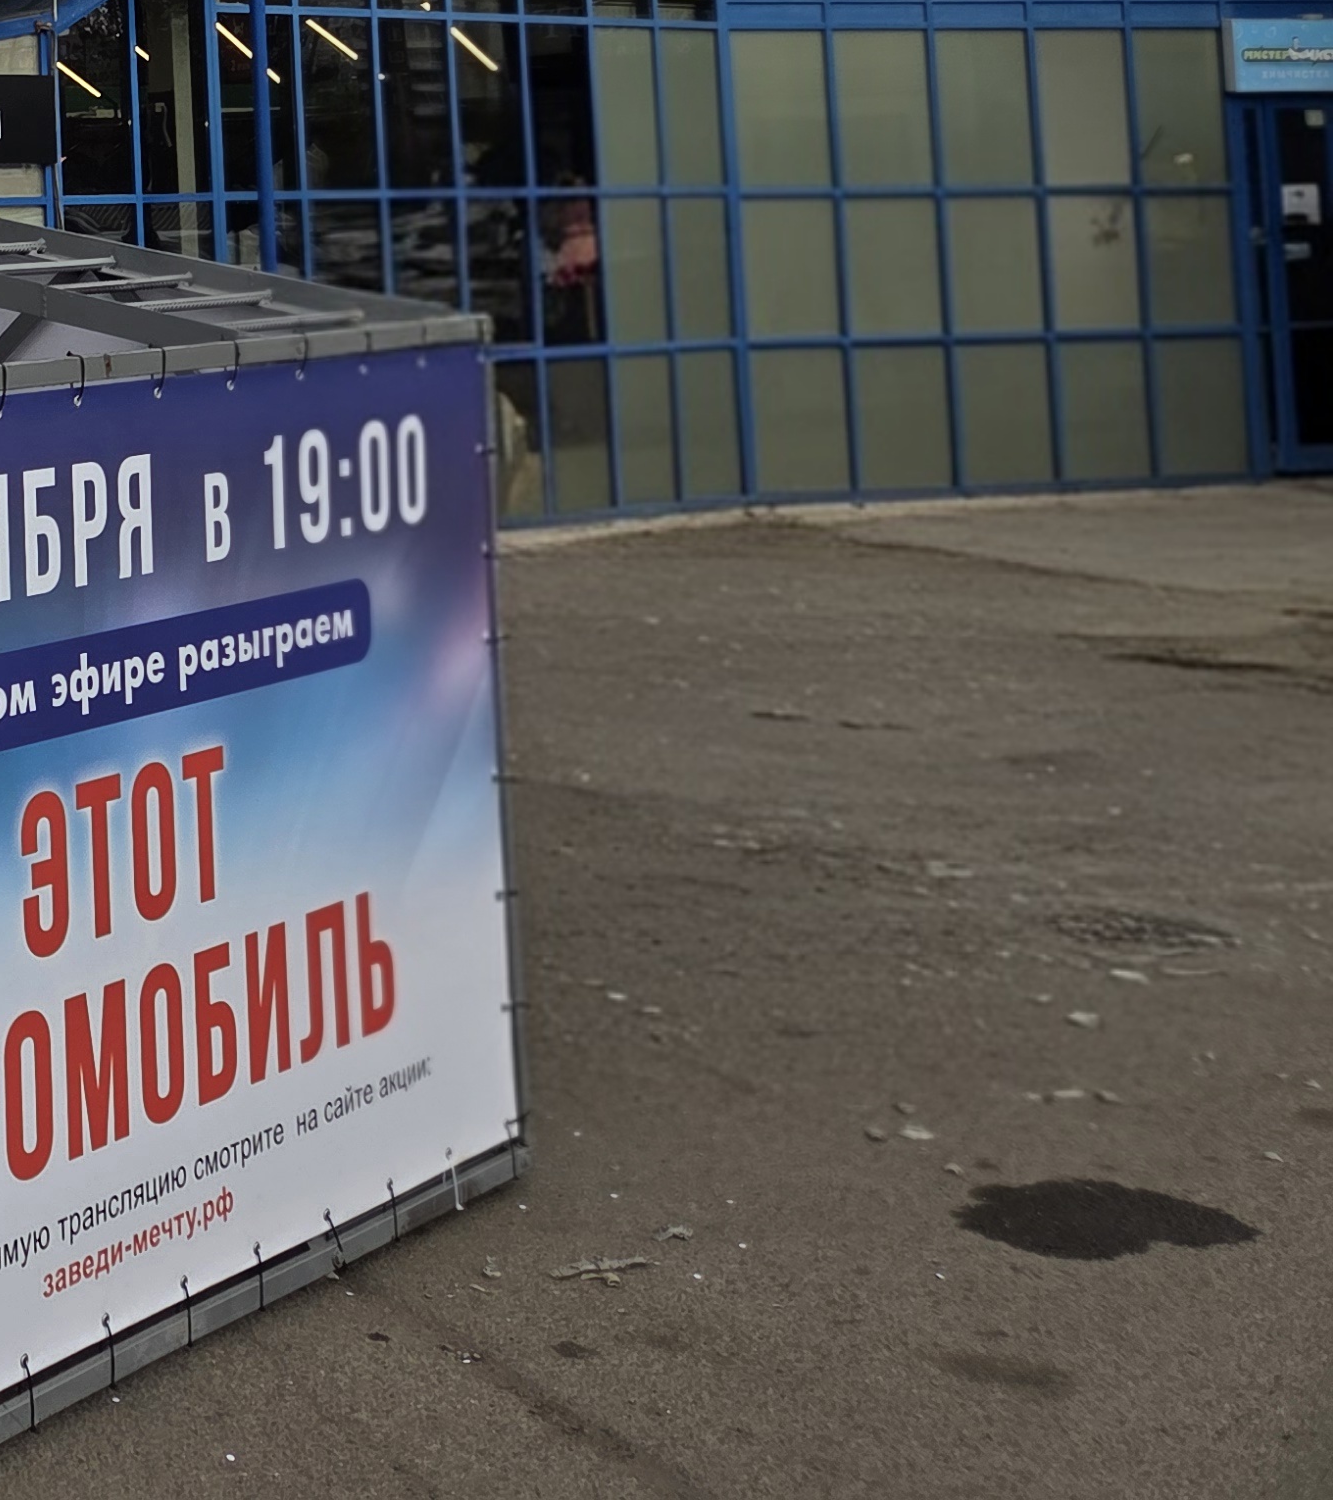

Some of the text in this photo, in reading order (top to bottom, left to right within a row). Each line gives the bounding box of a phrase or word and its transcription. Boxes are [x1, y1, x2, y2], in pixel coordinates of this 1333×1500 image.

[263, 414, 427, 550] 19:00
[51, 650, 166, 716] эфире
[177, 605, 354, 691] разыграем
[19, 745, 226, 958] ЭТОТ
[57, 1167, 188, 1245] трансляцию
[193, 1121, 285, 1181] смотрите
[296, 1107, 319, 1136] на
[323, 1080, 375, 1123] сайте
[379, 1055, 432, 1097] акции:
[43, 1184, 234, 1299] заведи-мечту.рф
